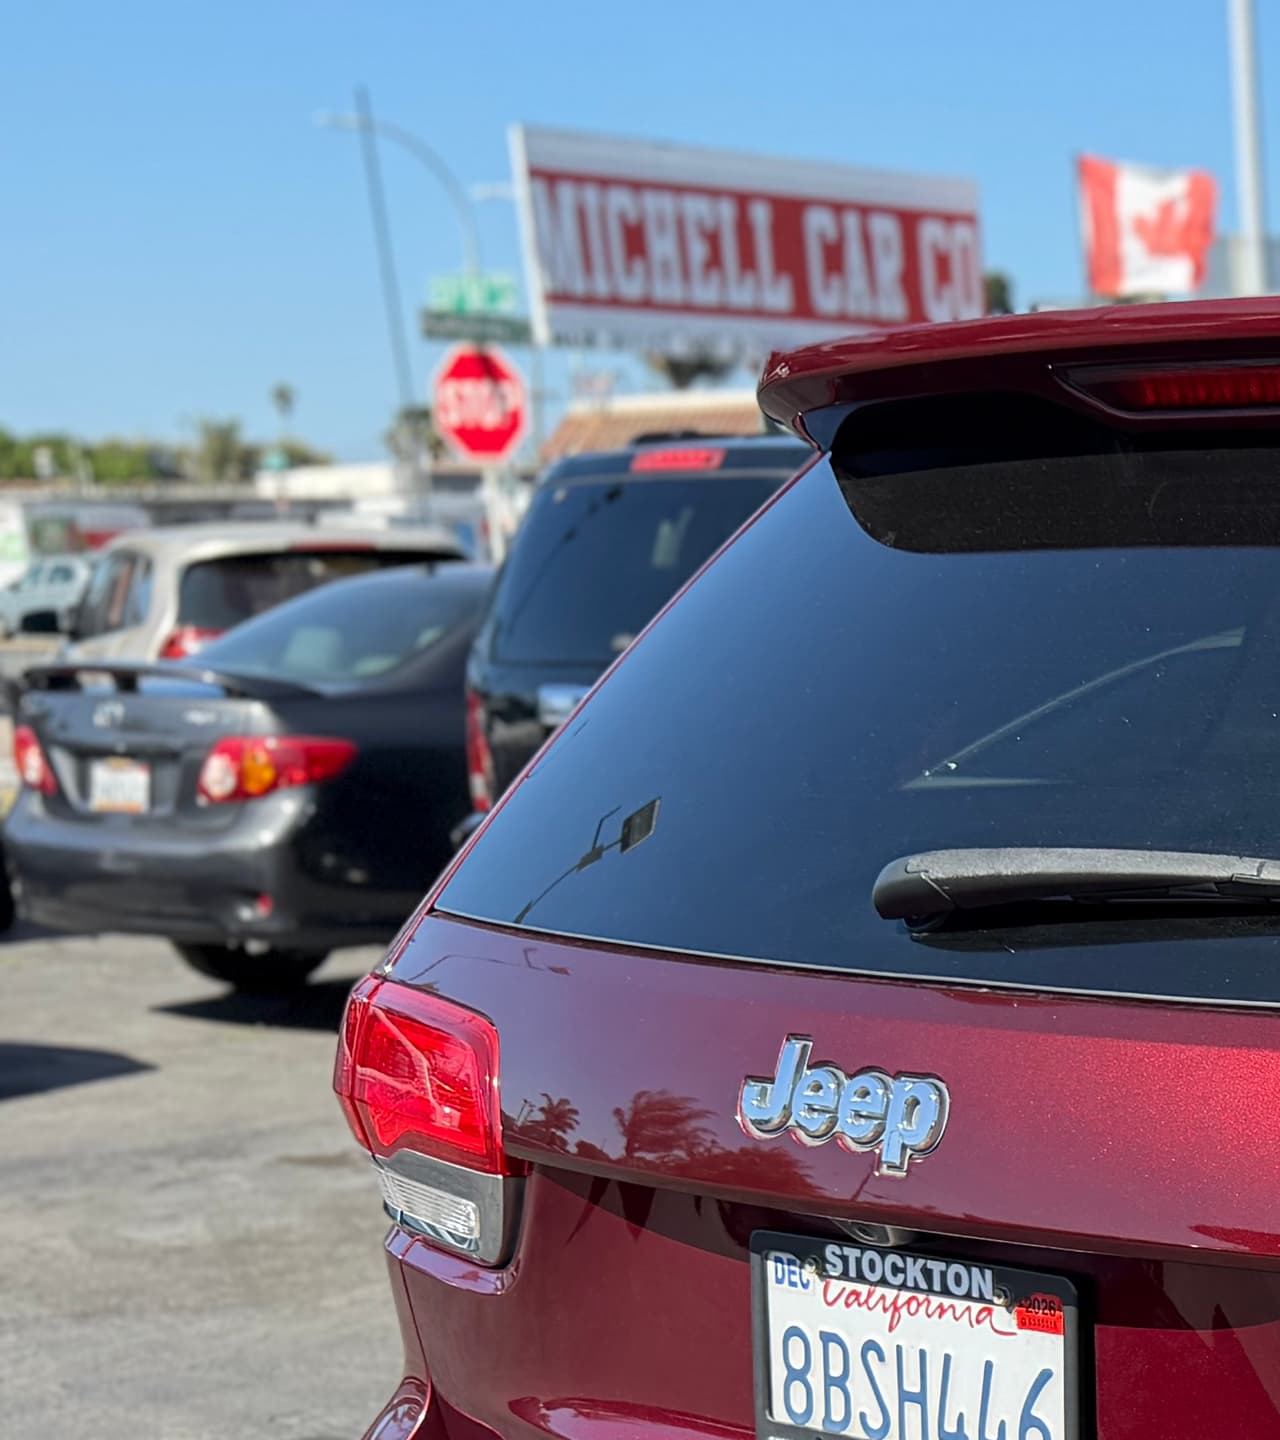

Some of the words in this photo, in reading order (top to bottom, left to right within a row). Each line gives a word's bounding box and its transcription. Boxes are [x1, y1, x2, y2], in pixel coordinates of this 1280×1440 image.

[531, 176, 792, 316] MICHELL
[804, 204, 909, 322] CAR
[917, 218, 984, 321] CO
[438, 380, 524, 429] STOP
[738, 1033, 949, 1177] Jeep
[774, 1255, 810, 1290] DEC
[824, 1244, 994, 1300] STOCKTON
[823, 1278, 1017, 1336] California
